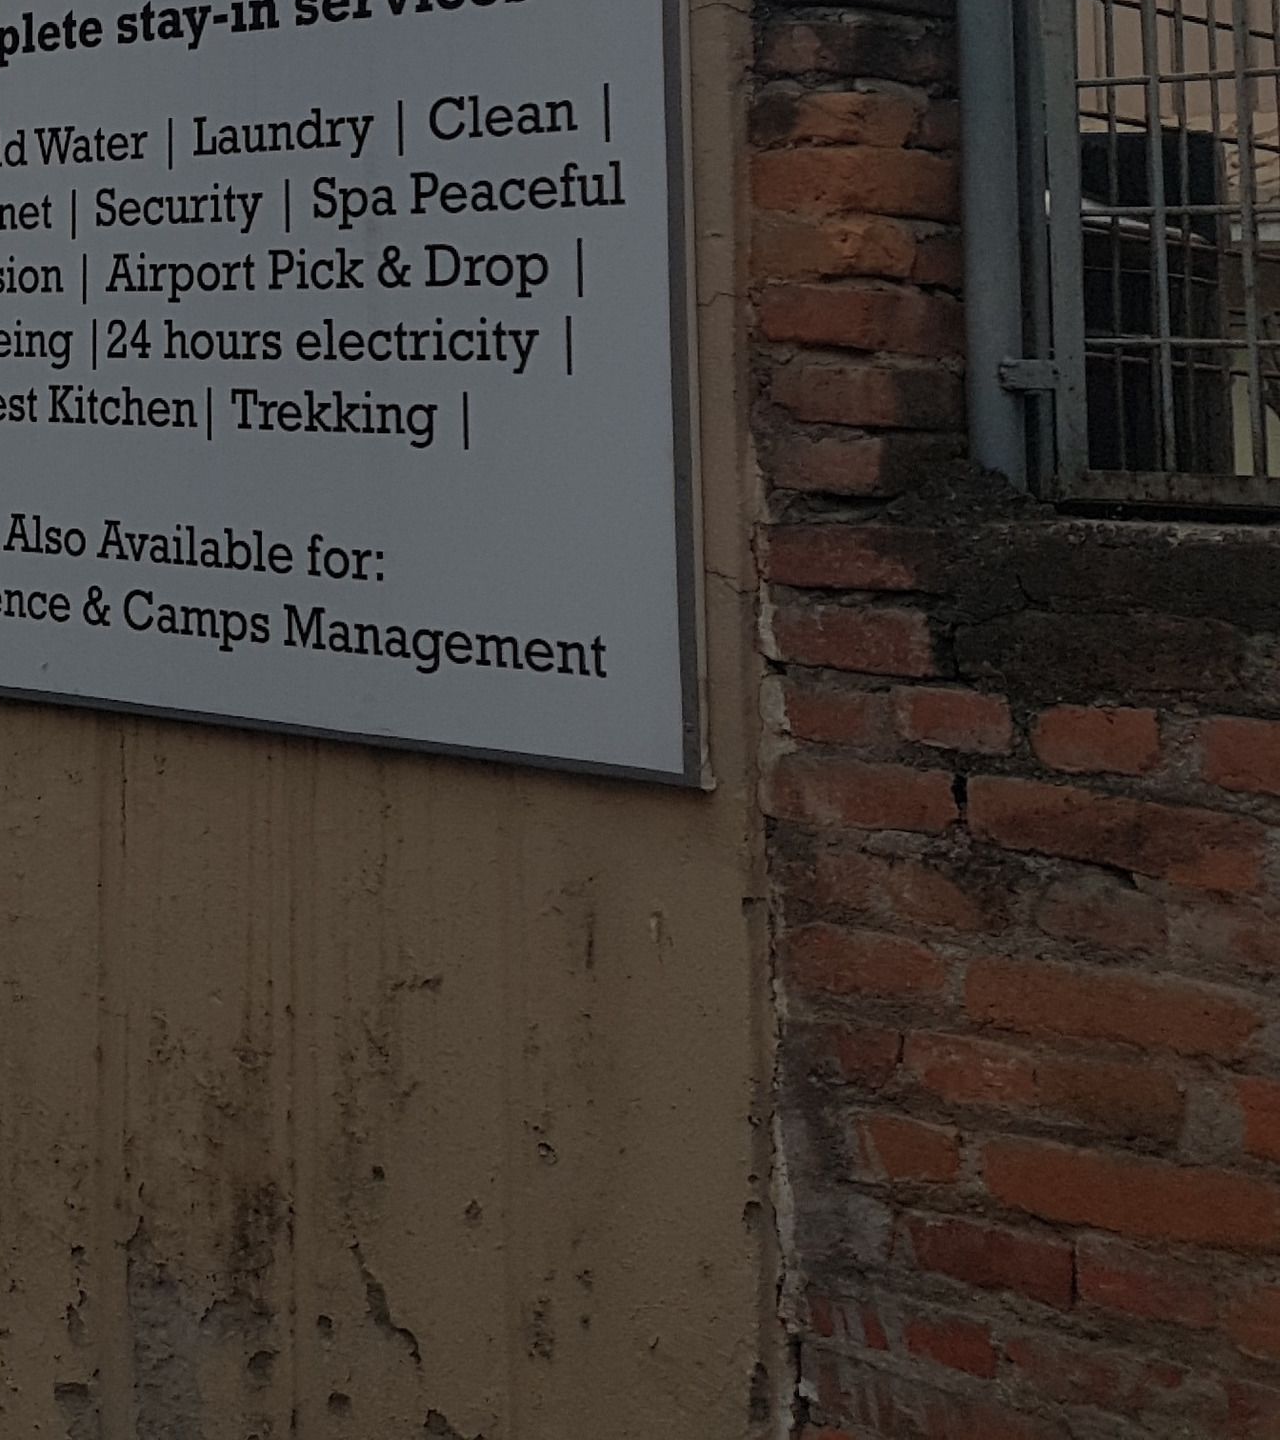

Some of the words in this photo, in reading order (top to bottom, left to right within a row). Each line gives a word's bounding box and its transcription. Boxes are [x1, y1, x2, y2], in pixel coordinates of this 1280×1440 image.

[34, 126, 148, 165] Water
[193, 108, 374, 159] Laundry
[429, 95, 578, 140] Clean
[96, 182, 263, 234] Security
[313, 177, 397, 230] Spa
[410, 160, 626, 215] Peaceful
[105, 252, 255, 303] Airport
[268, 247, 364, 290] Pick
[377, 245, 411, 288] &
[424, 244, 549, 299] Drop
[164, 319, 282, 361] hours
[296, 317, 539, 374] electricity
[231, 388, 438, 449] Trekking
[3, 513, 86, 558] Also
[96, 518, 293, 575] Available
[307, 533, 385, 582] for:
[83, 585, 111, 627] &
[123, 589, 270, 652] Camps
[283, 604, 607, 679] Management
